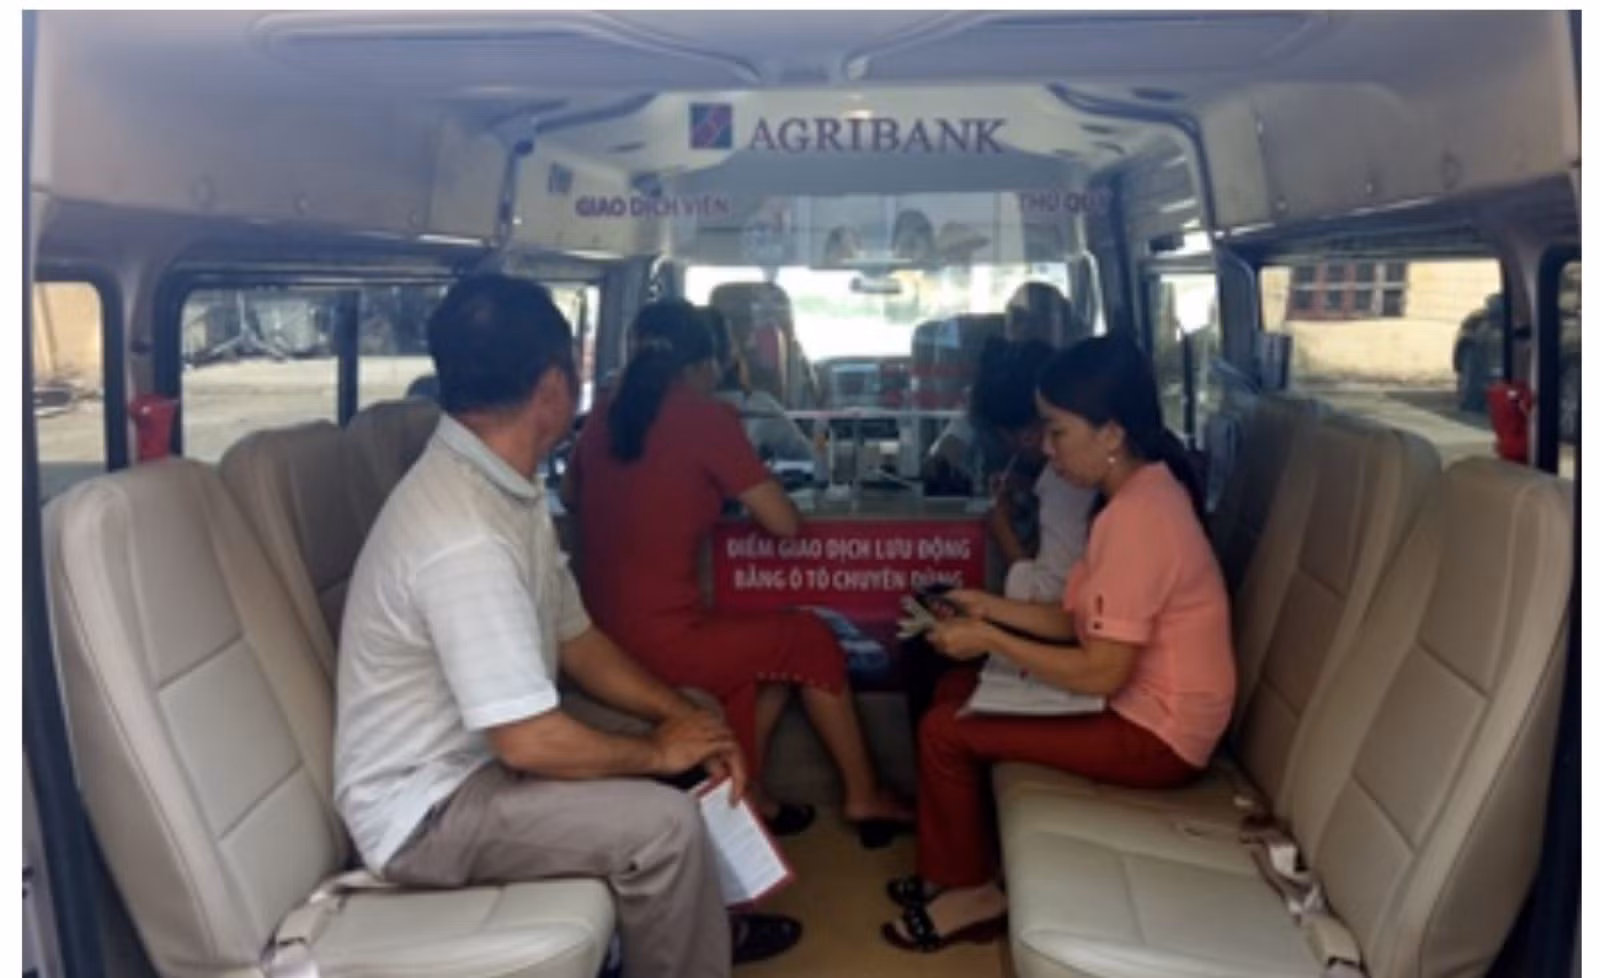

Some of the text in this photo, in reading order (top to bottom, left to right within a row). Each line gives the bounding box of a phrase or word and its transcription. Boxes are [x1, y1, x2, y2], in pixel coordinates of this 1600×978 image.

[749, 116, 1007, 153] AGRIBANK
[575, 195, 626, 217] GIAO
[778, 538, 823, 559] GIAO
[826, 538, 871, 562] DỊCH
[875, 537, 912, 560] LƯU
[918, 537, 970, 564] ĐỘNG
[790, 566, 803, 590] Ô
[805, 566, 830, 590] TÔ
[832, 567, 905, 591] CHUYÊN
